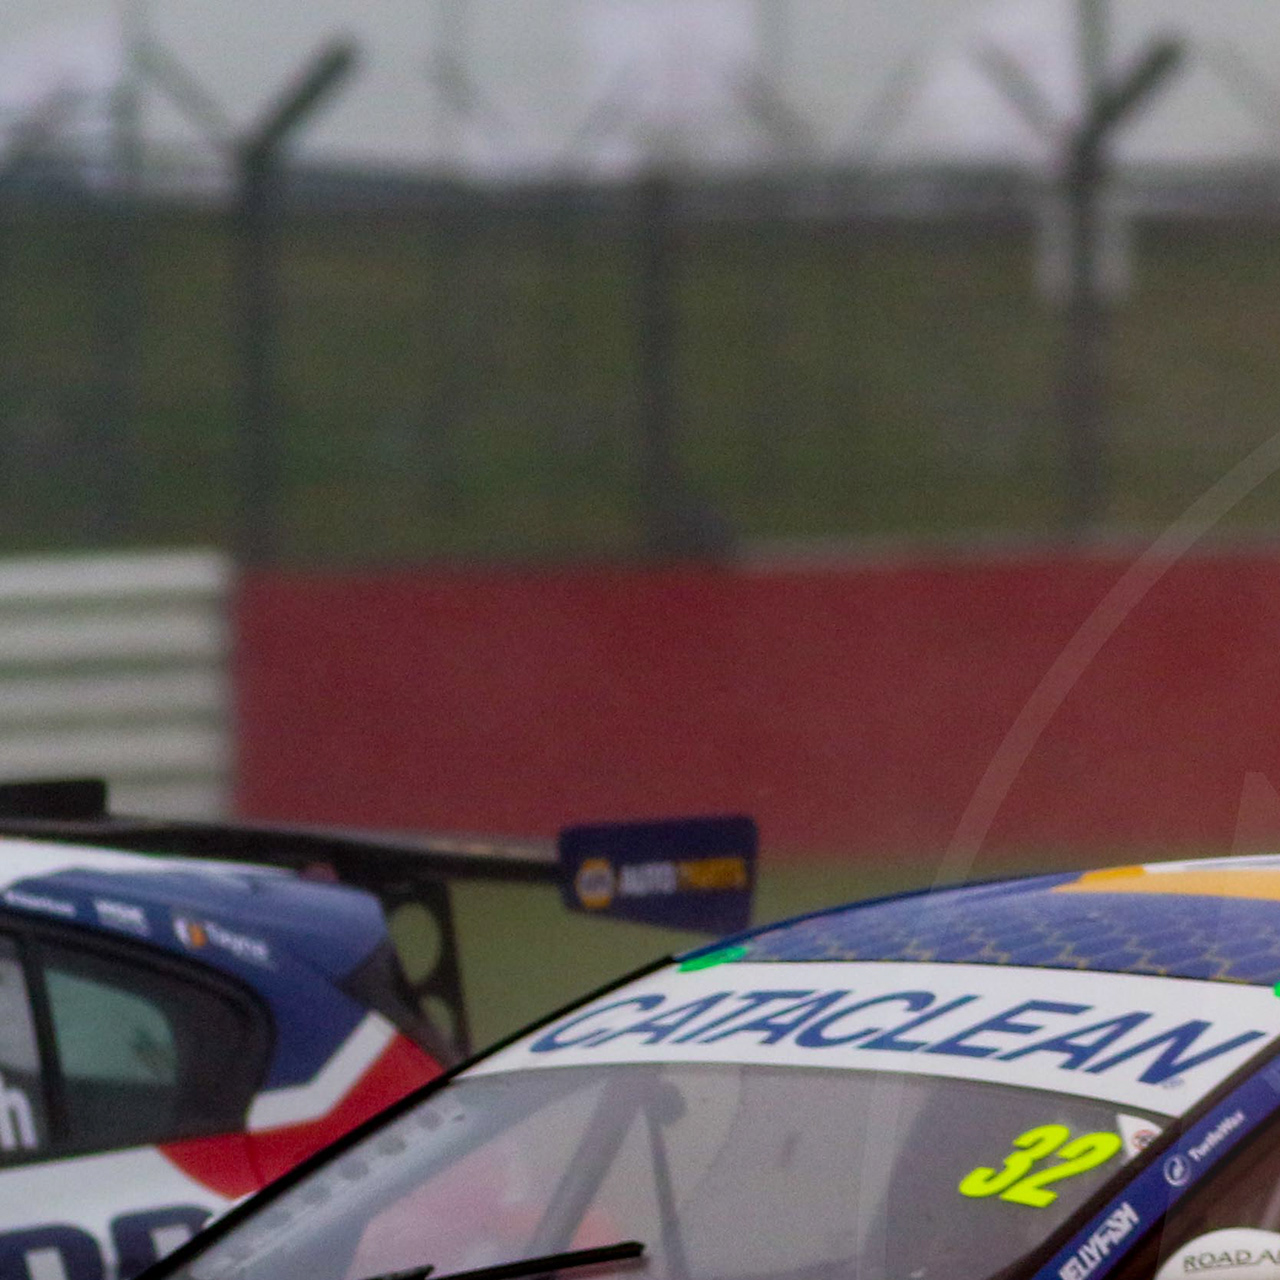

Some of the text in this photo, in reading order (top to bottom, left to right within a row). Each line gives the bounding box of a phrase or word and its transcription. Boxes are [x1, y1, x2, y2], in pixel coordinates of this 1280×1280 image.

[529, 988, 1266, 1088] CATACLEAN
[958, 1123, 1122, 1208] 32
[1183, 1249, 1253, 1273] ROAD
